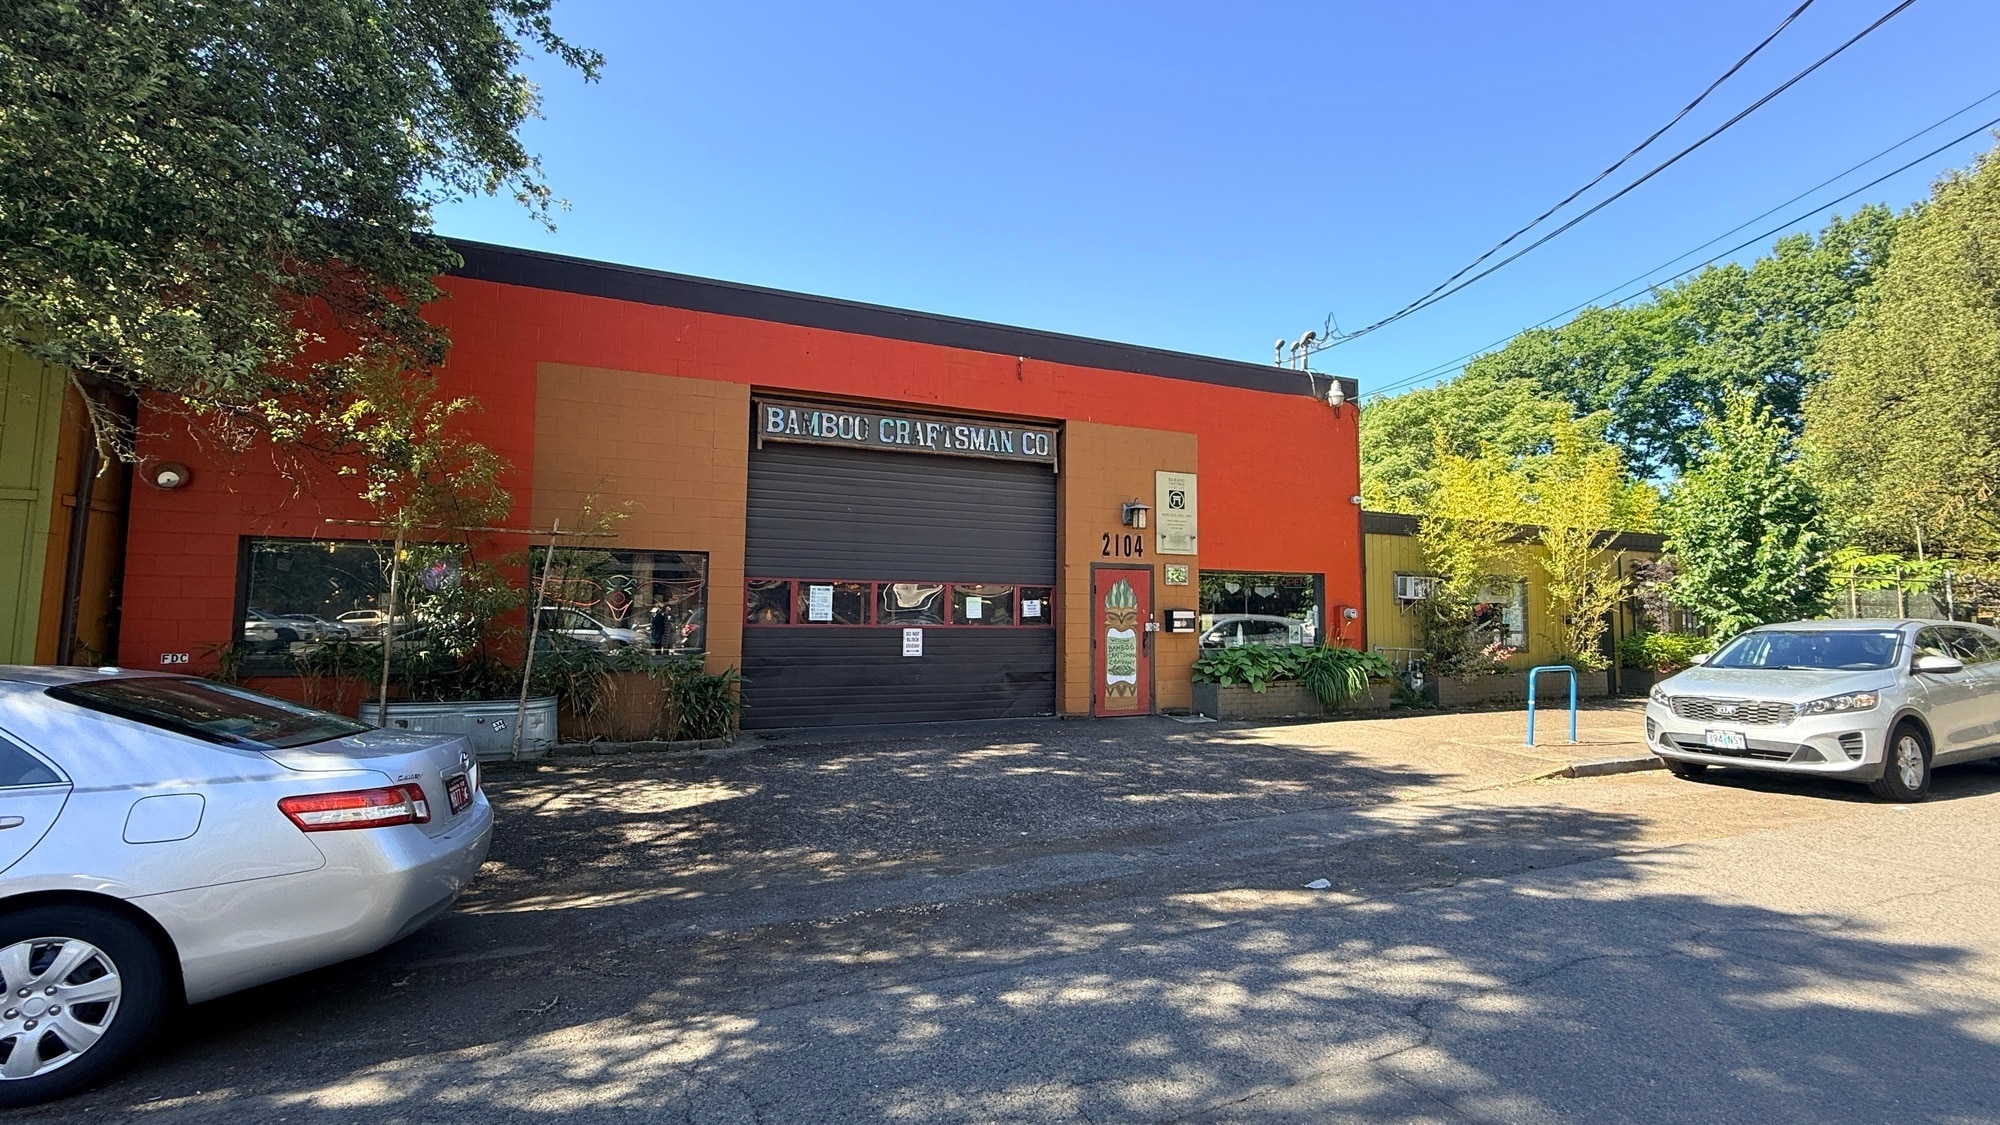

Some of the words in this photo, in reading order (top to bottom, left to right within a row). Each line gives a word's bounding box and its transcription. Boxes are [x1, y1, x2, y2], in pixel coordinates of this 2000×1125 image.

[766, 407, 869, 440] BAMBOO
[879, 418, 1014, 453] CRAFTSMAN
[1102, 532, 1143, 557] 2104
[1280, 576, 1307, 586] OPEN
[1108, 643, 1135, 652] BAMBOO
[162, 654, 187, 663] FDC
[1708, 733, 1722, 743] 394
